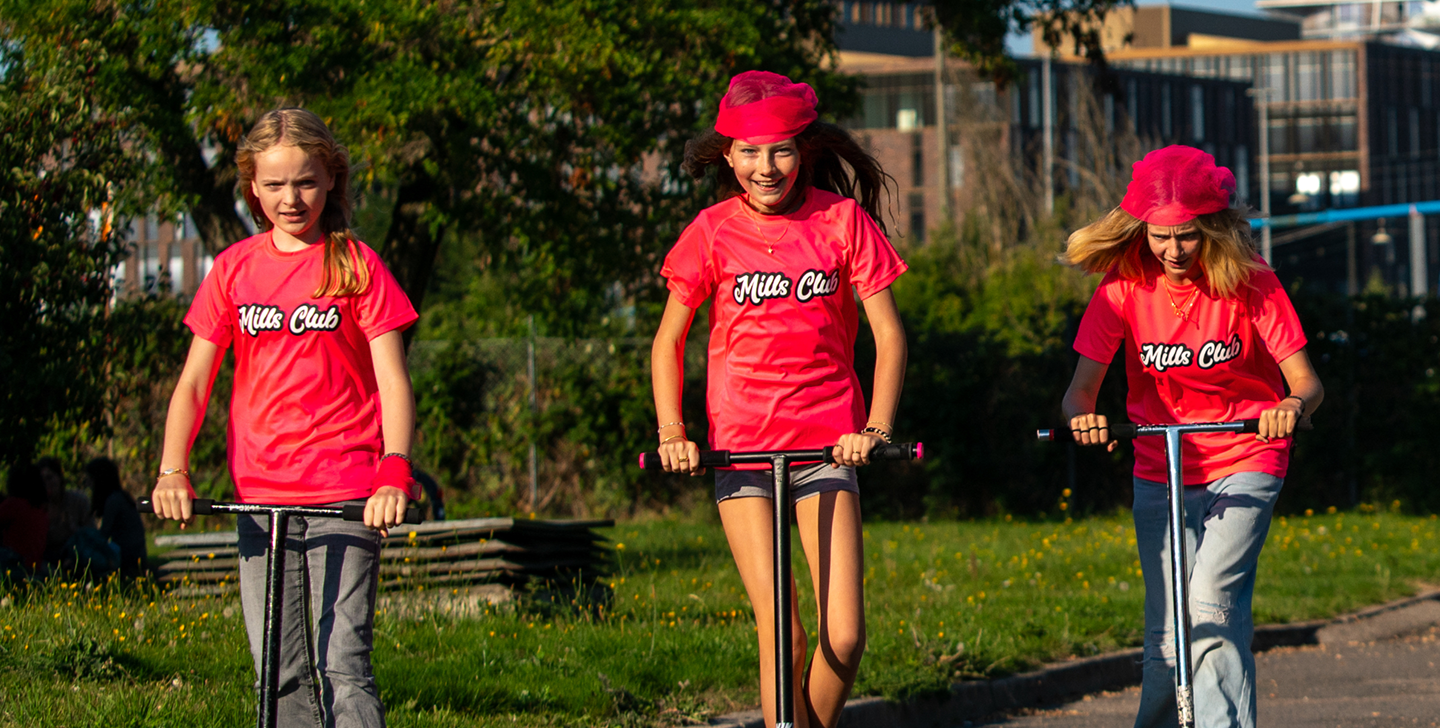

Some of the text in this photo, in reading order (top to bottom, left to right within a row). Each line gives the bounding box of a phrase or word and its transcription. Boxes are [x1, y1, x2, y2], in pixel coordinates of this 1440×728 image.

[733, 270, 839, 305] Mills Club
[237, 304, 340, 336] Mills Club
[1139, 337, 1241, 372] Mills Club
